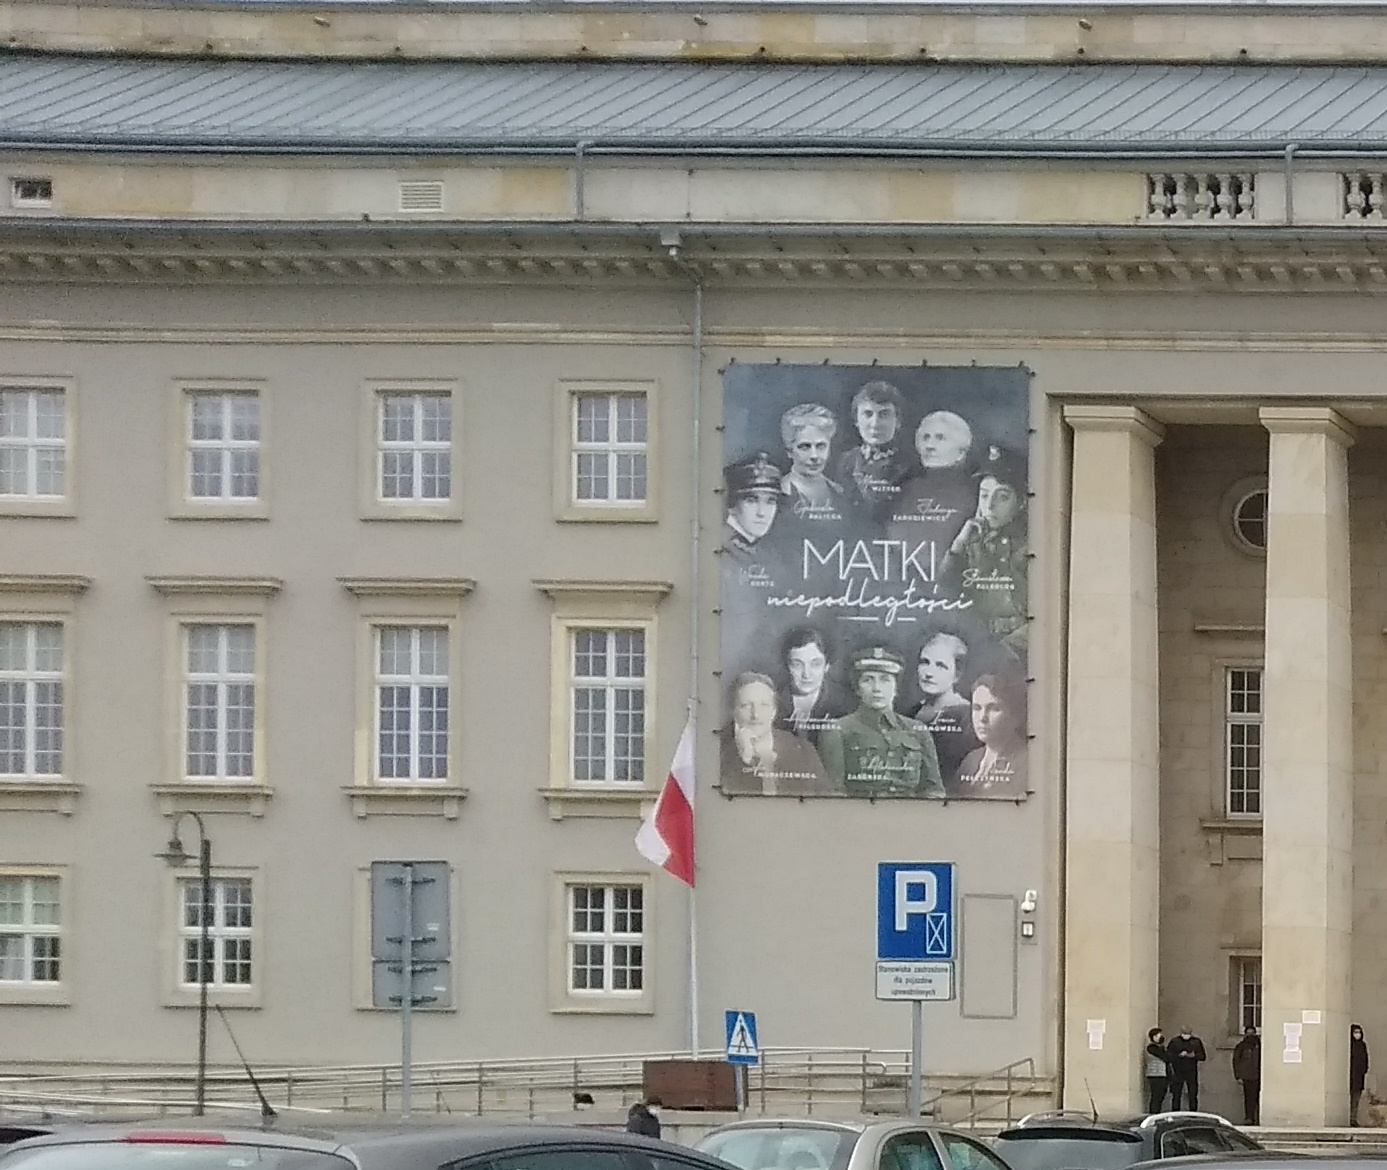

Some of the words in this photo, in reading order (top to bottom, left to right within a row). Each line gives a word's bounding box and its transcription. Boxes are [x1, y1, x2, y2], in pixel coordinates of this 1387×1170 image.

[803, 538, 936, 582] MATKI
[767, 577, 974, 628] niepodległości
[895, 870, 937, 931] P
